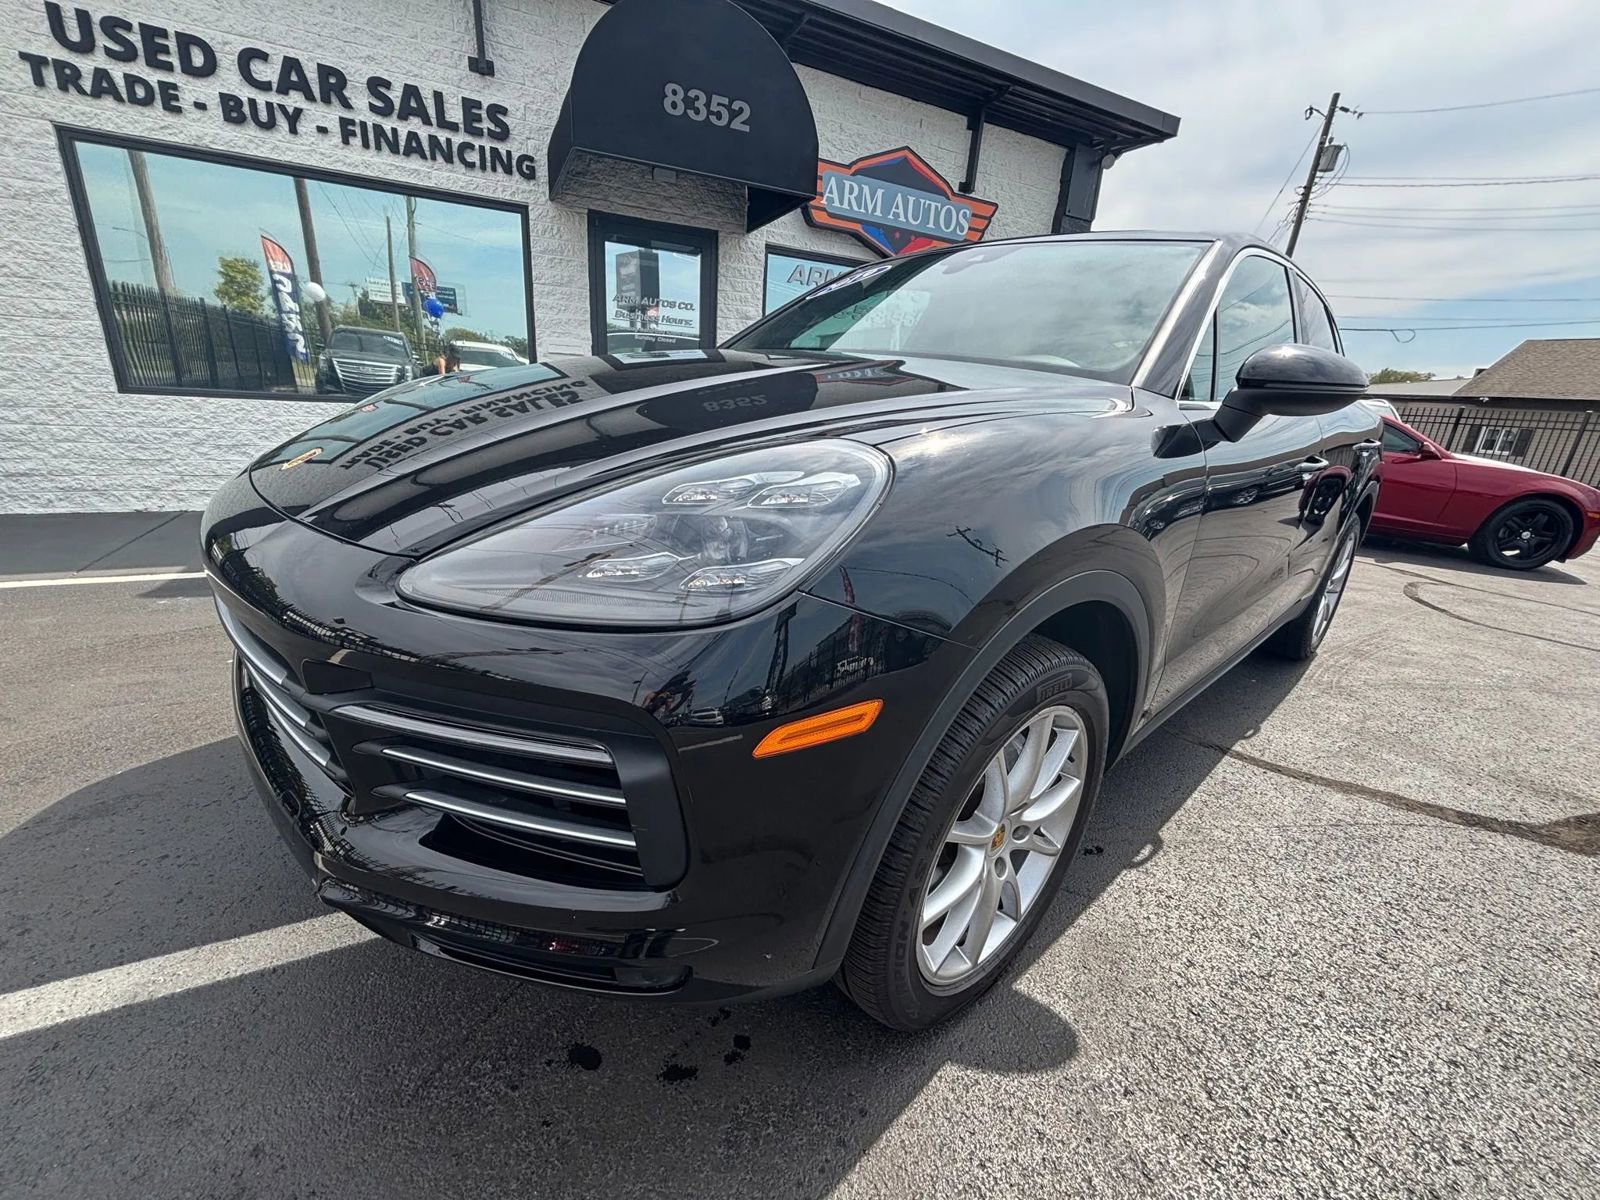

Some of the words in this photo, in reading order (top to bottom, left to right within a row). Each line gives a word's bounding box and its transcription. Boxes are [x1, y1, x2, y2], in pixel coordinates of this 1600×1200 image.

[44, 0, 217, 78] USED
[237, 47, 354, 110] CAR
[366, 75, 510, 142] SALES
[18, 51, 182, 114] TRADE
[193, 100, 207, 111] -
[218, 92, 303, 135] BUY
[316, 125, 329, 134] -
[338, 116, 536, 180] FINANCING
[663, 82, 751, 133] 8352
[820, 176, 885, 217] ARM
[887, 193, 971, 236] AUTOS
[612, 294, 639, 305] ARM
[641, 296, 677, 309] AUTOS
[677, 301, 696, 311] CO.
